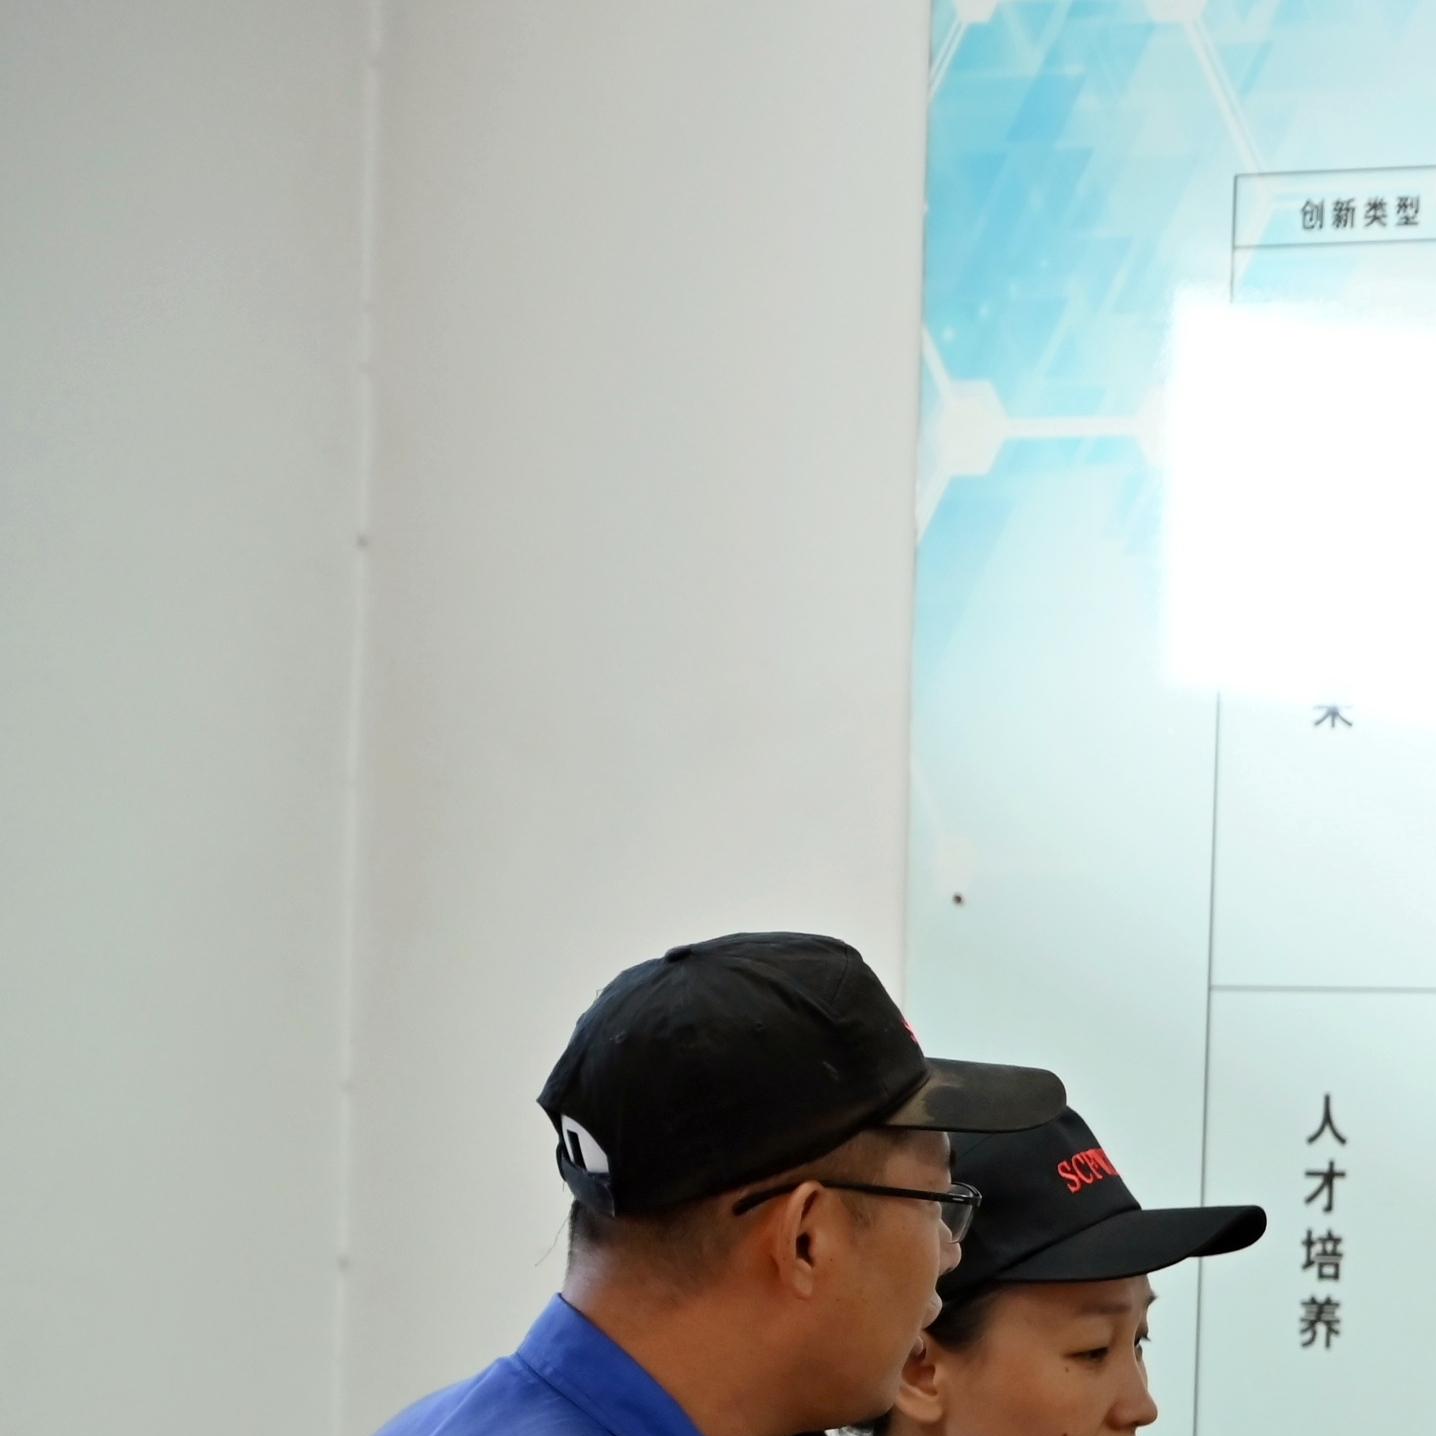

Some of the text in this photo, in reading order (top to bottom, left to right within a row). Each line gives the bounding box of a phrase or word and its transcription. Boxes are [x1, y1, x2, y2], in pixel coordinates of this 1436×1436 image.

[1299, 196, 1422, 231] 创新类型
[1299, 1093, 1348, 1351] 人才培养
